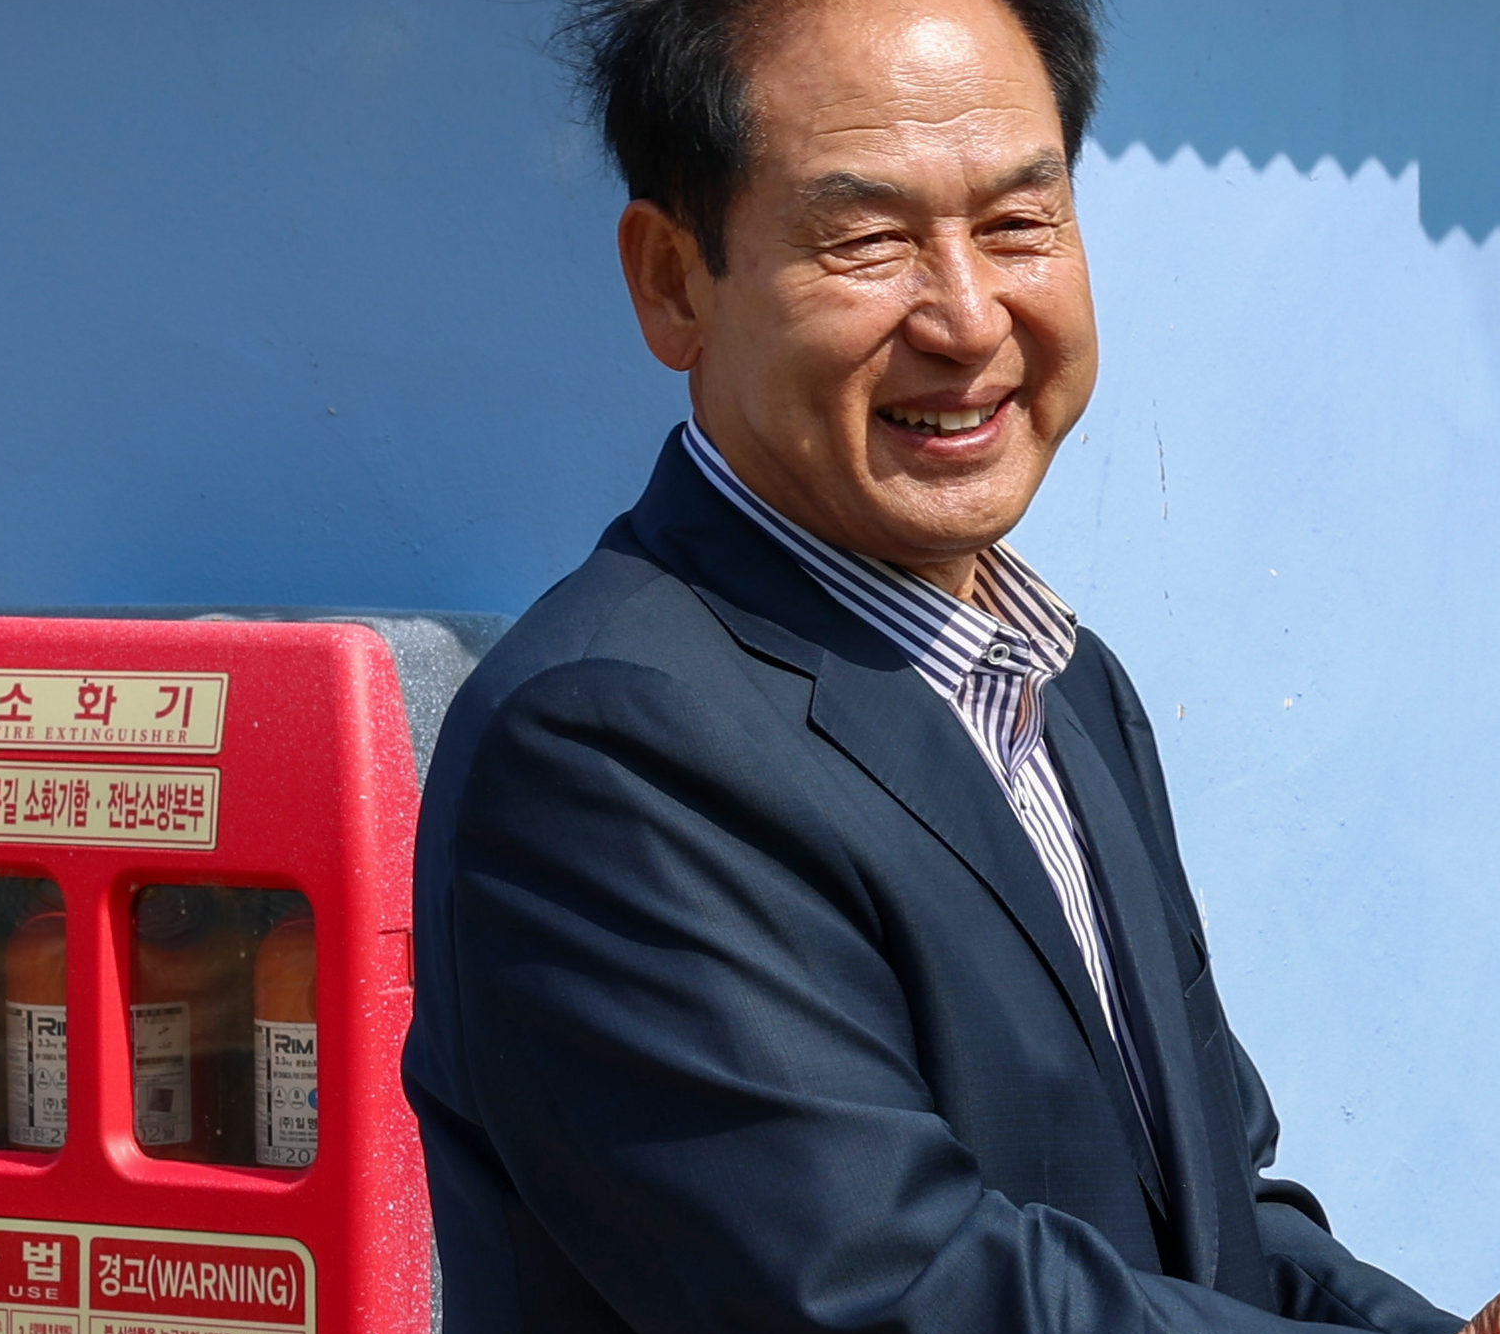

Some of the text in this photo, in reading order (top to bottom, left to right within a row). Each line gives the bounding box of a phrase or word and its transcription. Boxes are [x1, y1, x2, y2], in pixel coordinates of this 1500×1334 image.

[45, 727, 188, 743] EXTINGUISHER
[23, 778, 90, 828] 소화기함
[107, 781, 205, 832] 전남소방본부
[274, 1033, 314, 1055] RIM
[8, 1285, 59, 1300] USE
[98, 1253, 298, 1311] 경고(WARNING)
